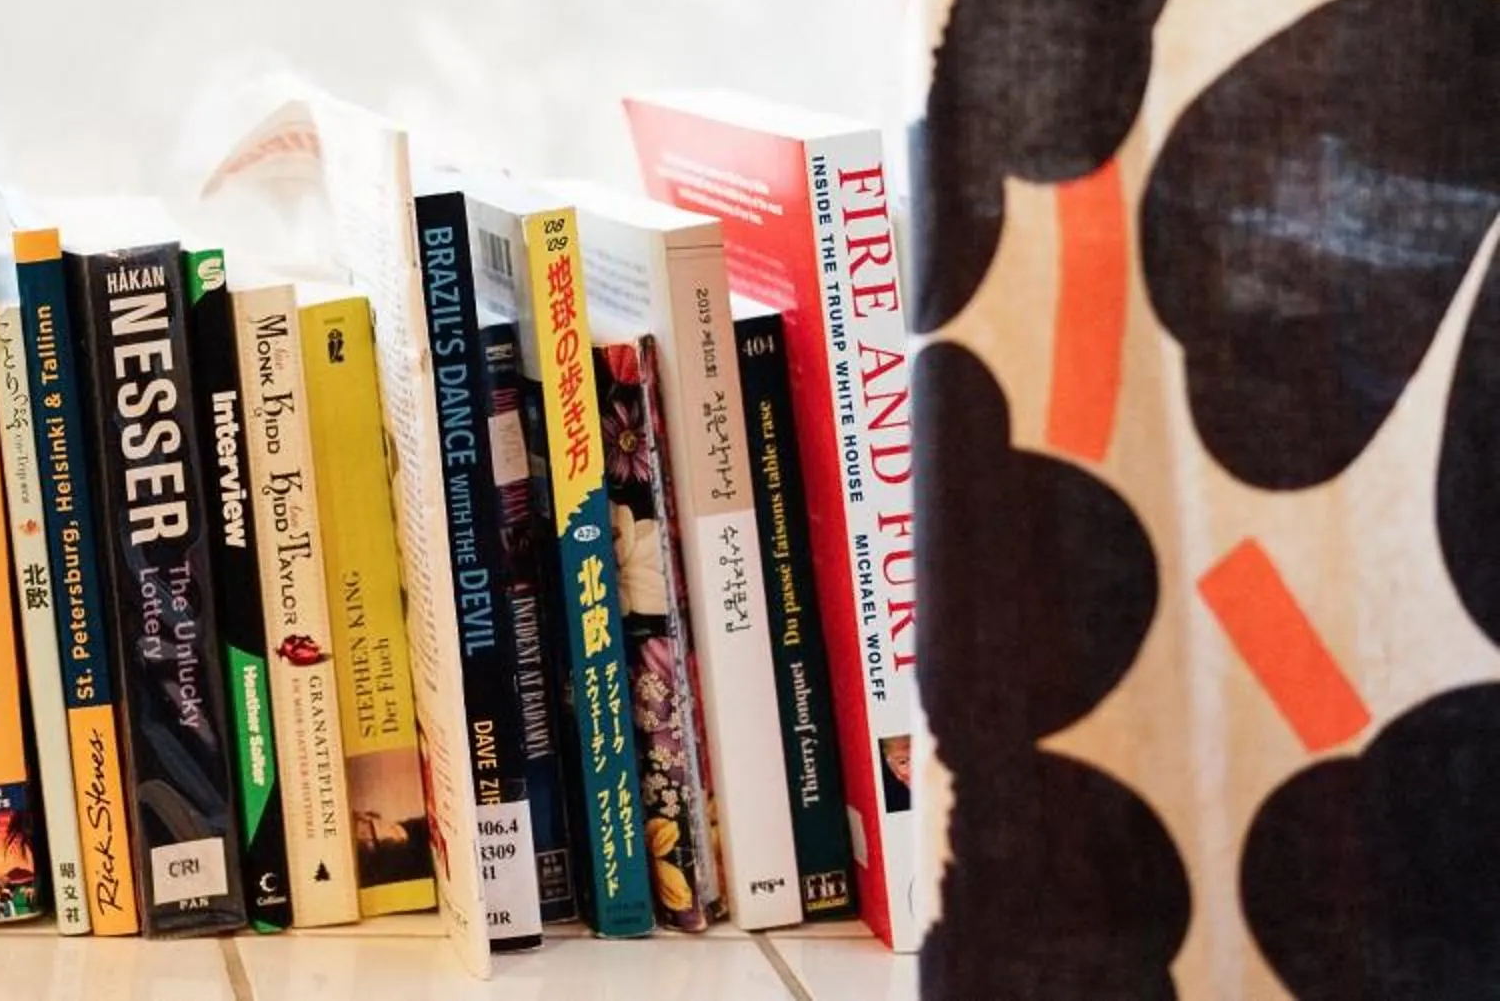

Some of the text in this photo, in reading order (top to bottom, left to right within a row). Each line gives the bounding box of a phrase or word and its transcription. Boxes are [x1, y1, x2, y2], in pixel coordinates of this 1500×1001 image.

[106, 266, 166, 295] HÅKAN
[542, 217, 566, 235] '08
[546, 235, 569, 252] '09
[837, 161, 900, 319] FIRE
[546, 253, 592, 481] 地球の歩き方
[695, 286, 711, 325] 2019
[810, 155, 864, 503] INSIDE THE TRUMP WHITE HOUSE
[108, 293, 190, 547] NESSER
[250, 314, 296, 455] MONK KIDD
[422, 226, 496, 657] BRAZIL'S DANCE WITH THE DEVIL
[703, 390, 737, 500] 젊은작가상
[856, 339, 914, 485] AND
[35, 304, 97, 701] St. Petersburg, Helsinki & Tallinn
[211, 390, 248, 549] Interview
[758, 400, 803, 646] Du passé faisons table rase
[22, 563, 50, 611] 北欧
[262, 469, 312, 626] KIDD TAYLOR
[576, 554, 613, 658] 北欧
[718, 524, 752, 634] 수상작품집
[138, 566, 165, 661] Lottery
[168, 560, 205, 731] The Unlucky
[343, 570, 378, 739] STEPHEN KING
[511, 597, 542, 662] INCIDENT
[854, 533, 887, 702] MICHAEL WOLFF
[243, 664, 267, 787] Heather Salter
[373, 637, 400, 735] Der Fluch
[472, 719, 499, 770] DAVE
[604, 660, 625, 755] デンマーク
[789, 662, 820, 808] Thierry Jonquet
[307, 674, 338, 839] GRANATEPLENE
[92, 841, 125, 917] Rick
[167, 856, 201, 879] CRI
[596, 788, 620, 899] フィンランド
